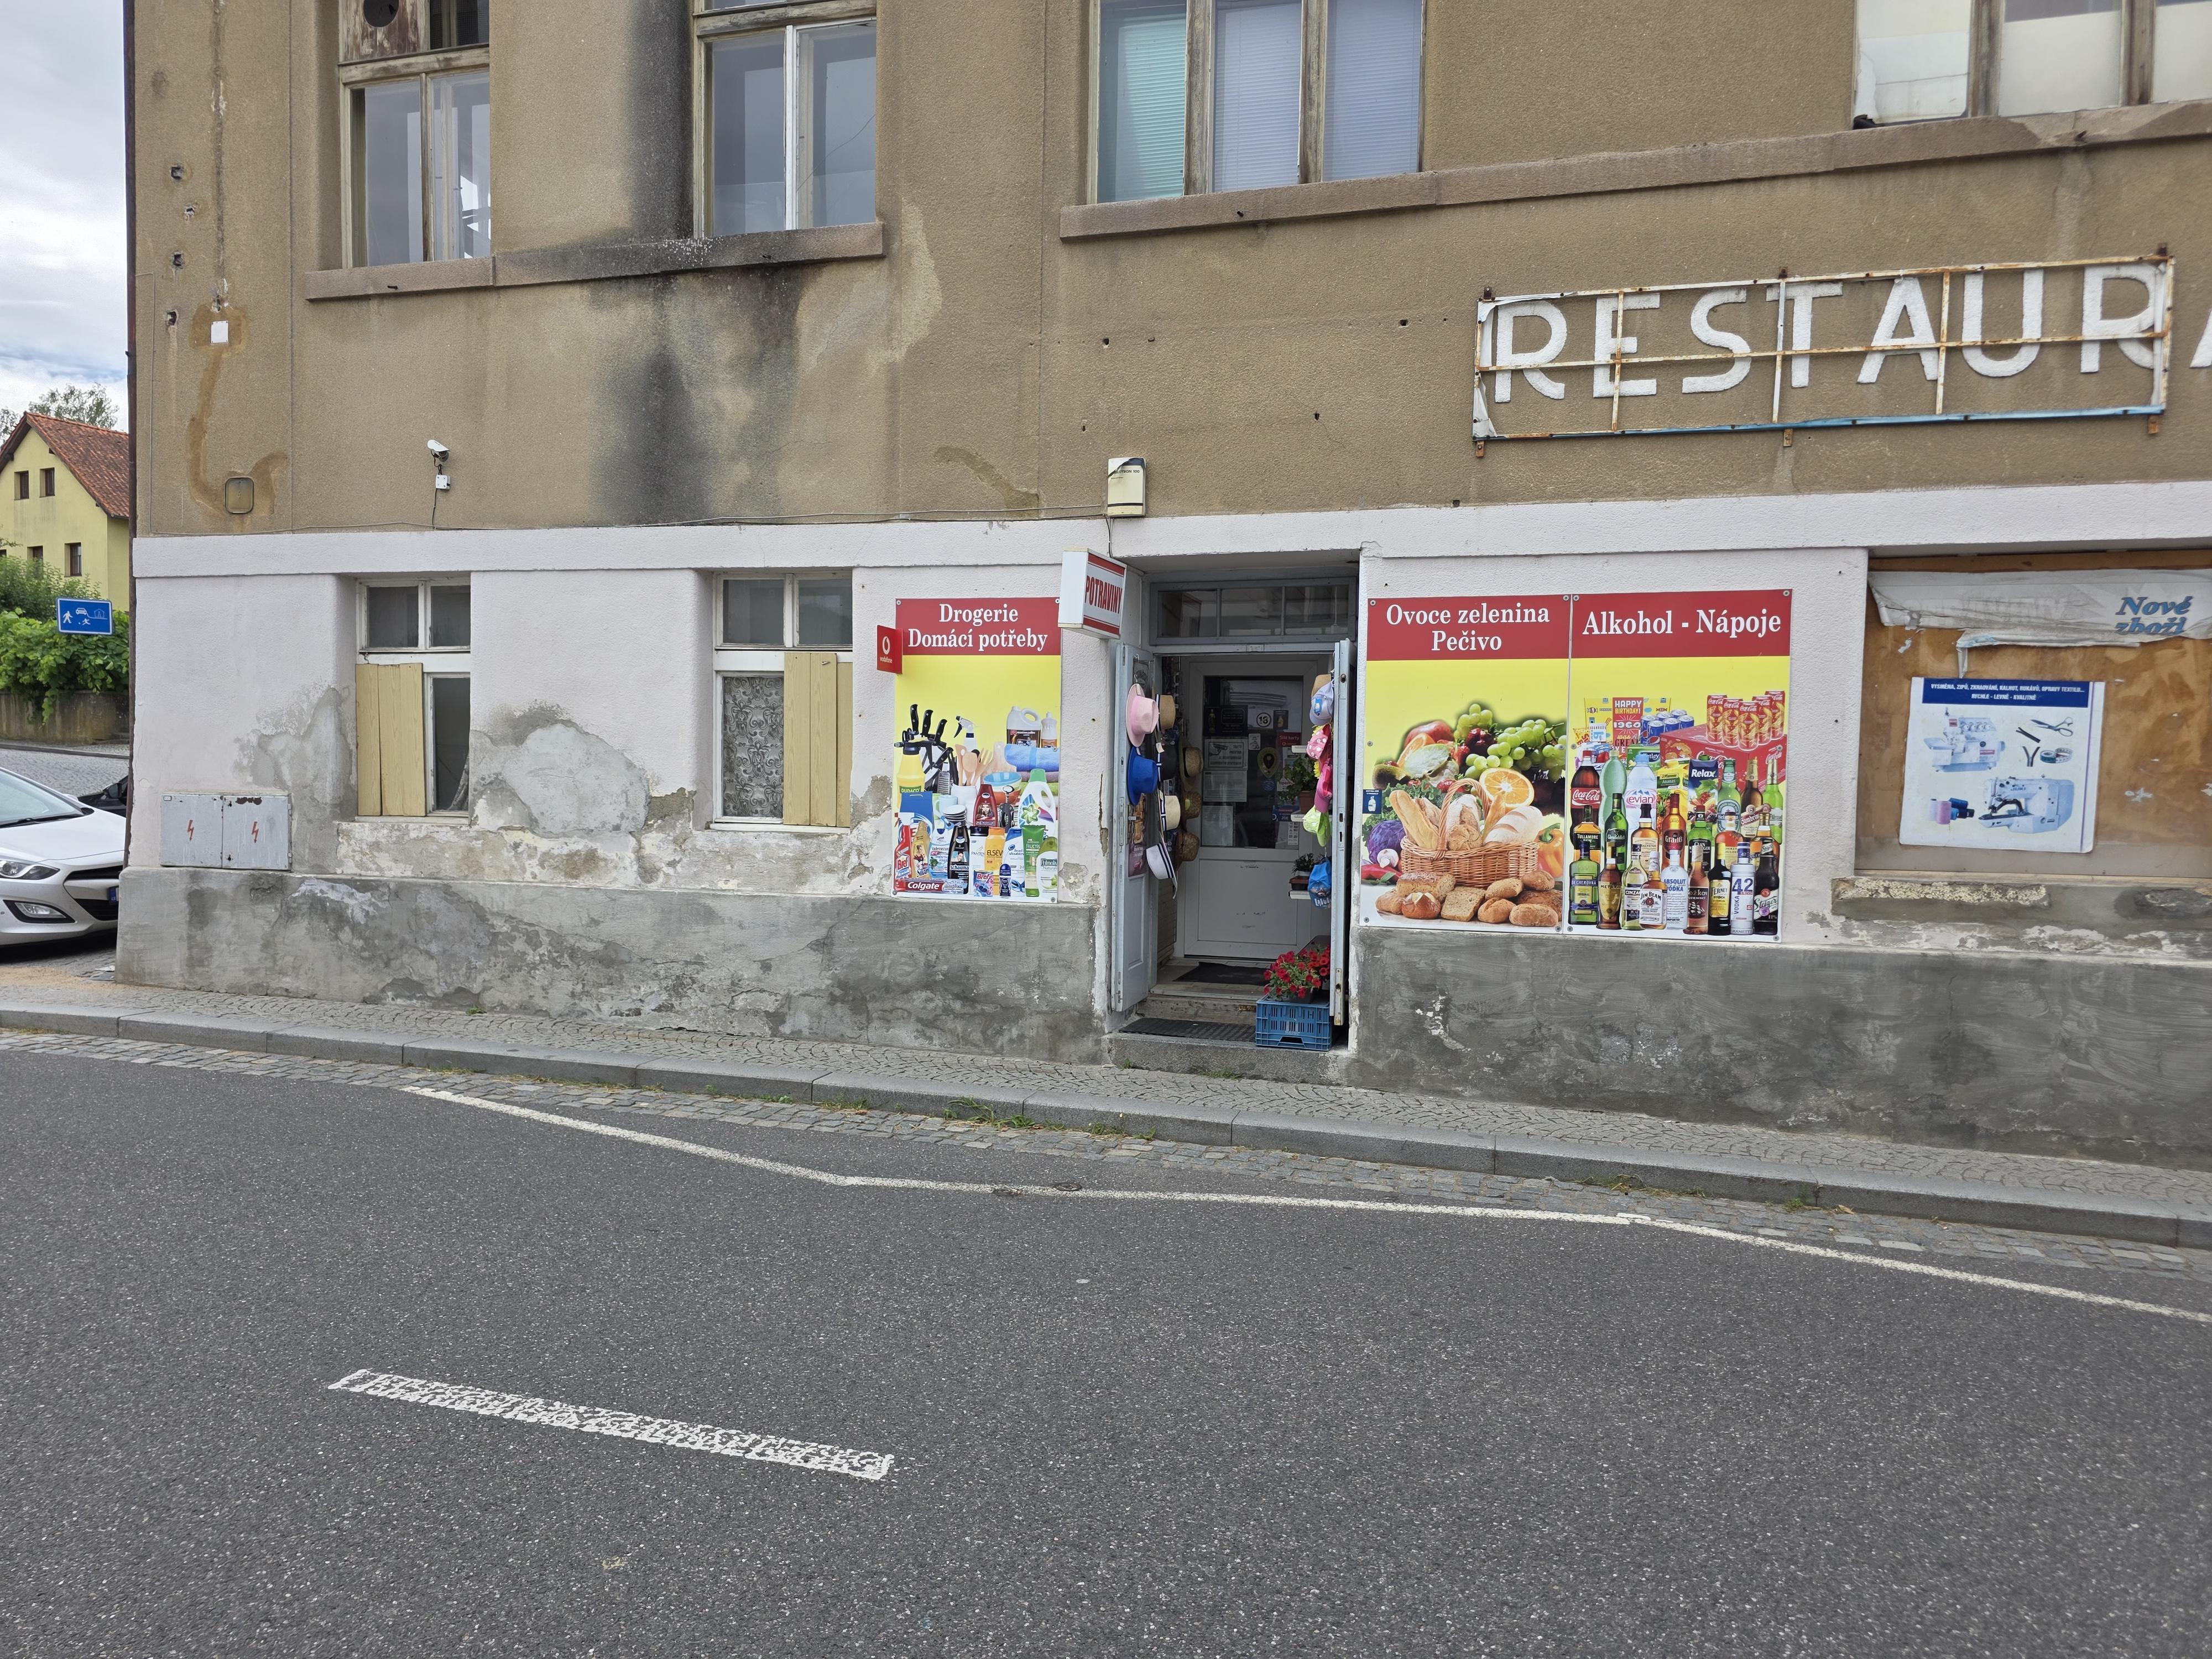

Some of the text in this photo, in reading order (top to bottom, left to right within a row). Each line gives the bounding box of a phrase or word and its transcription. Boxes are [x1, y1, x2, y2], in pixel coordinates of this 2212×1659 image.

[1495, 262, 2212, 403] RESTAUR
[1084, 575, 1123, 614] POTRAVINY
[939, 603, 1018, 626] Drogerie
[1386, 602, 1550, 625] Ovoce zelenina
[2115, 596, 2193, 615] Nové
[1582, 611, 1673, 634] Alkohol
[1695, 608, 1781, 638] Nápoje
[908, 628, 1048, 651] Domácí potřeby
[1431, 630, 1502, 651] Pečivo
[1691, 769, 1715, 778] Relax
[1573, 789, 1600, 801] Coca-Cola
[1629, 795, 1653, 804] evian
[907, 882, 940, 890] Colgate
[1648, 891, 1661, 900] BEAM
[1712, 888, 1728, 896] FERNET
[1732, 878, 1753, 895] 42
